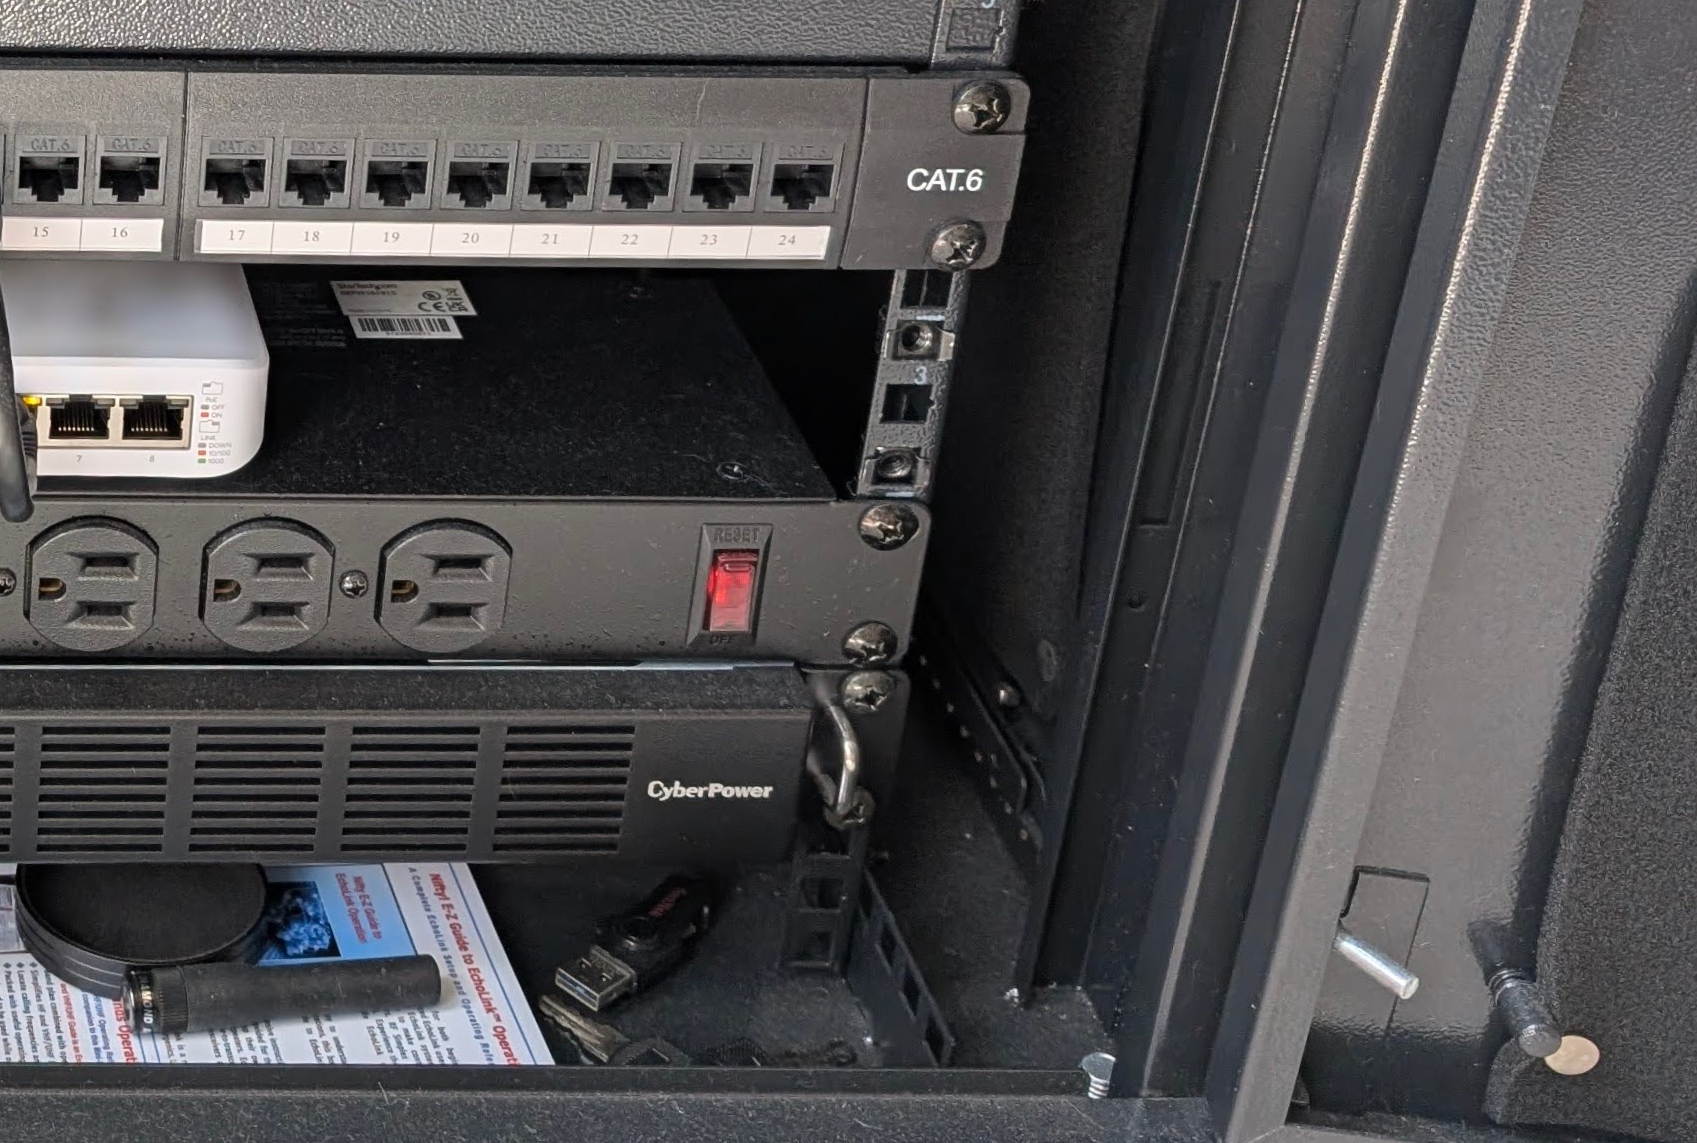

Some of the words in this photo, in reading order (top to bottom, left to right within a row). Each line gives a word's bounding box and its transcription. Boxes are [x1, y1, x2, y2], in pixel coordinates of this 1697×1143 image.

[31, 138, 71, 152] CAT.6
[112, 138, 152, 152] CAT.6
[906, 167, 984, 193] CAT.6
[33, 226, 49, 239] 15
[112, 226, 129, 239] 16
[228, 229, 245, 241] 17
[303, 230, 320, 242] 18
[383, 230, 400, 243] 19
[462, 231, 480, 244] 20
[541, 232, 559, 244] 21
[620, 233, 638, 246] 22
[700, 233, 718, 246] 23
[778, 233, 796, 246] 24
[914, 366, 927, 385] 3
[76, 455, 82, 463] 7
[149, 455, 155, 463] 8
[713, 527, 760, 543] RESET
[709, 633, 735, 645] OFF
[647, 780, 773, 801] CyberPower
[429, 874, 450, 900] Nifty!
[441, 904, 457, 920] E-Z
[348, 908, 368, 943] Operation
[365, 909, 379, 930] Guide
[448, 923, 468, 951] Guide
[411, 876, 432, 912] Complete
[427, 915, 447, 952] EchoLink
[442, 955, 457, 978] Setup
[452, 981, 466, 996] and
[460, 999, 485, 1040] Operating
[463, 954, 473, 965] to
